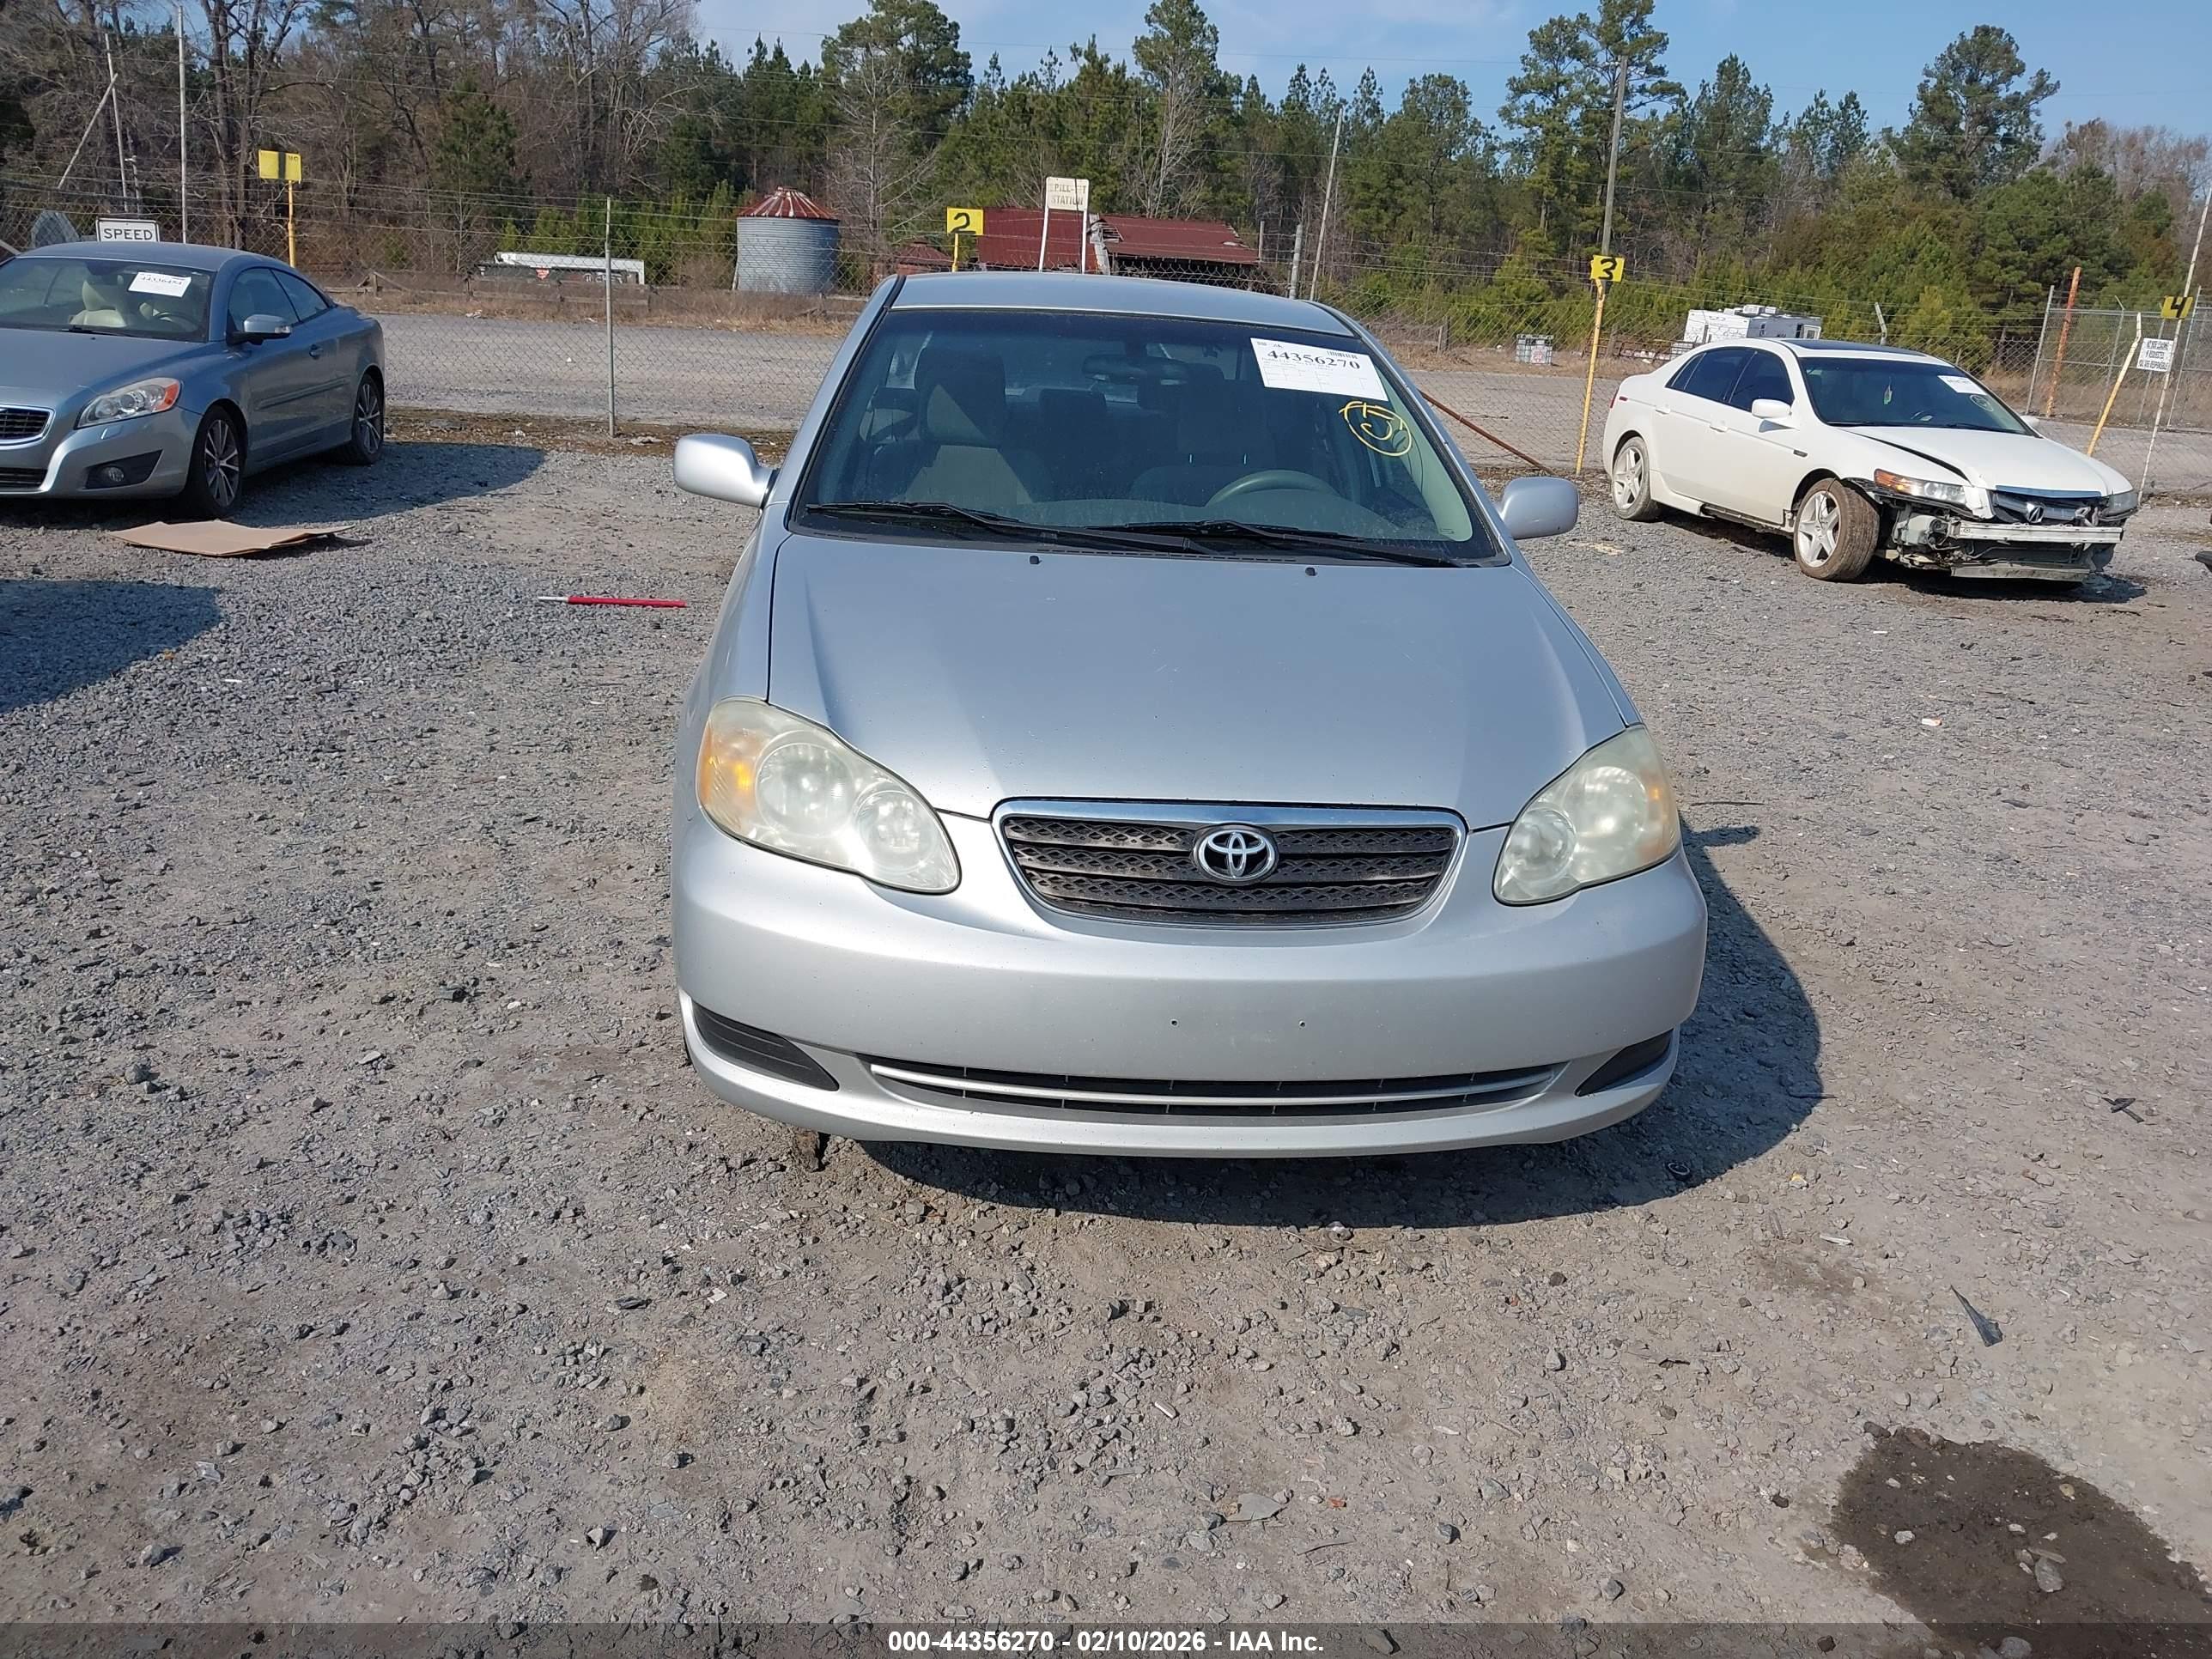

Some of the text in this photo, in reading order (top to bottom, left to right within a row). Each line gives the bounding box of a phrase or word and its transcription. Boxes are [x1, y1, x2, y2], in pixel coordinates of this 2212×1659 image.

[104, 228, 153, 240] SPEED
[950, 212, 976, 234] 2
[1598, 258, 1617, 280] 3
[2171, 296, 2188, 318] 4
[1267, 350, 1361, 369] 44356270
